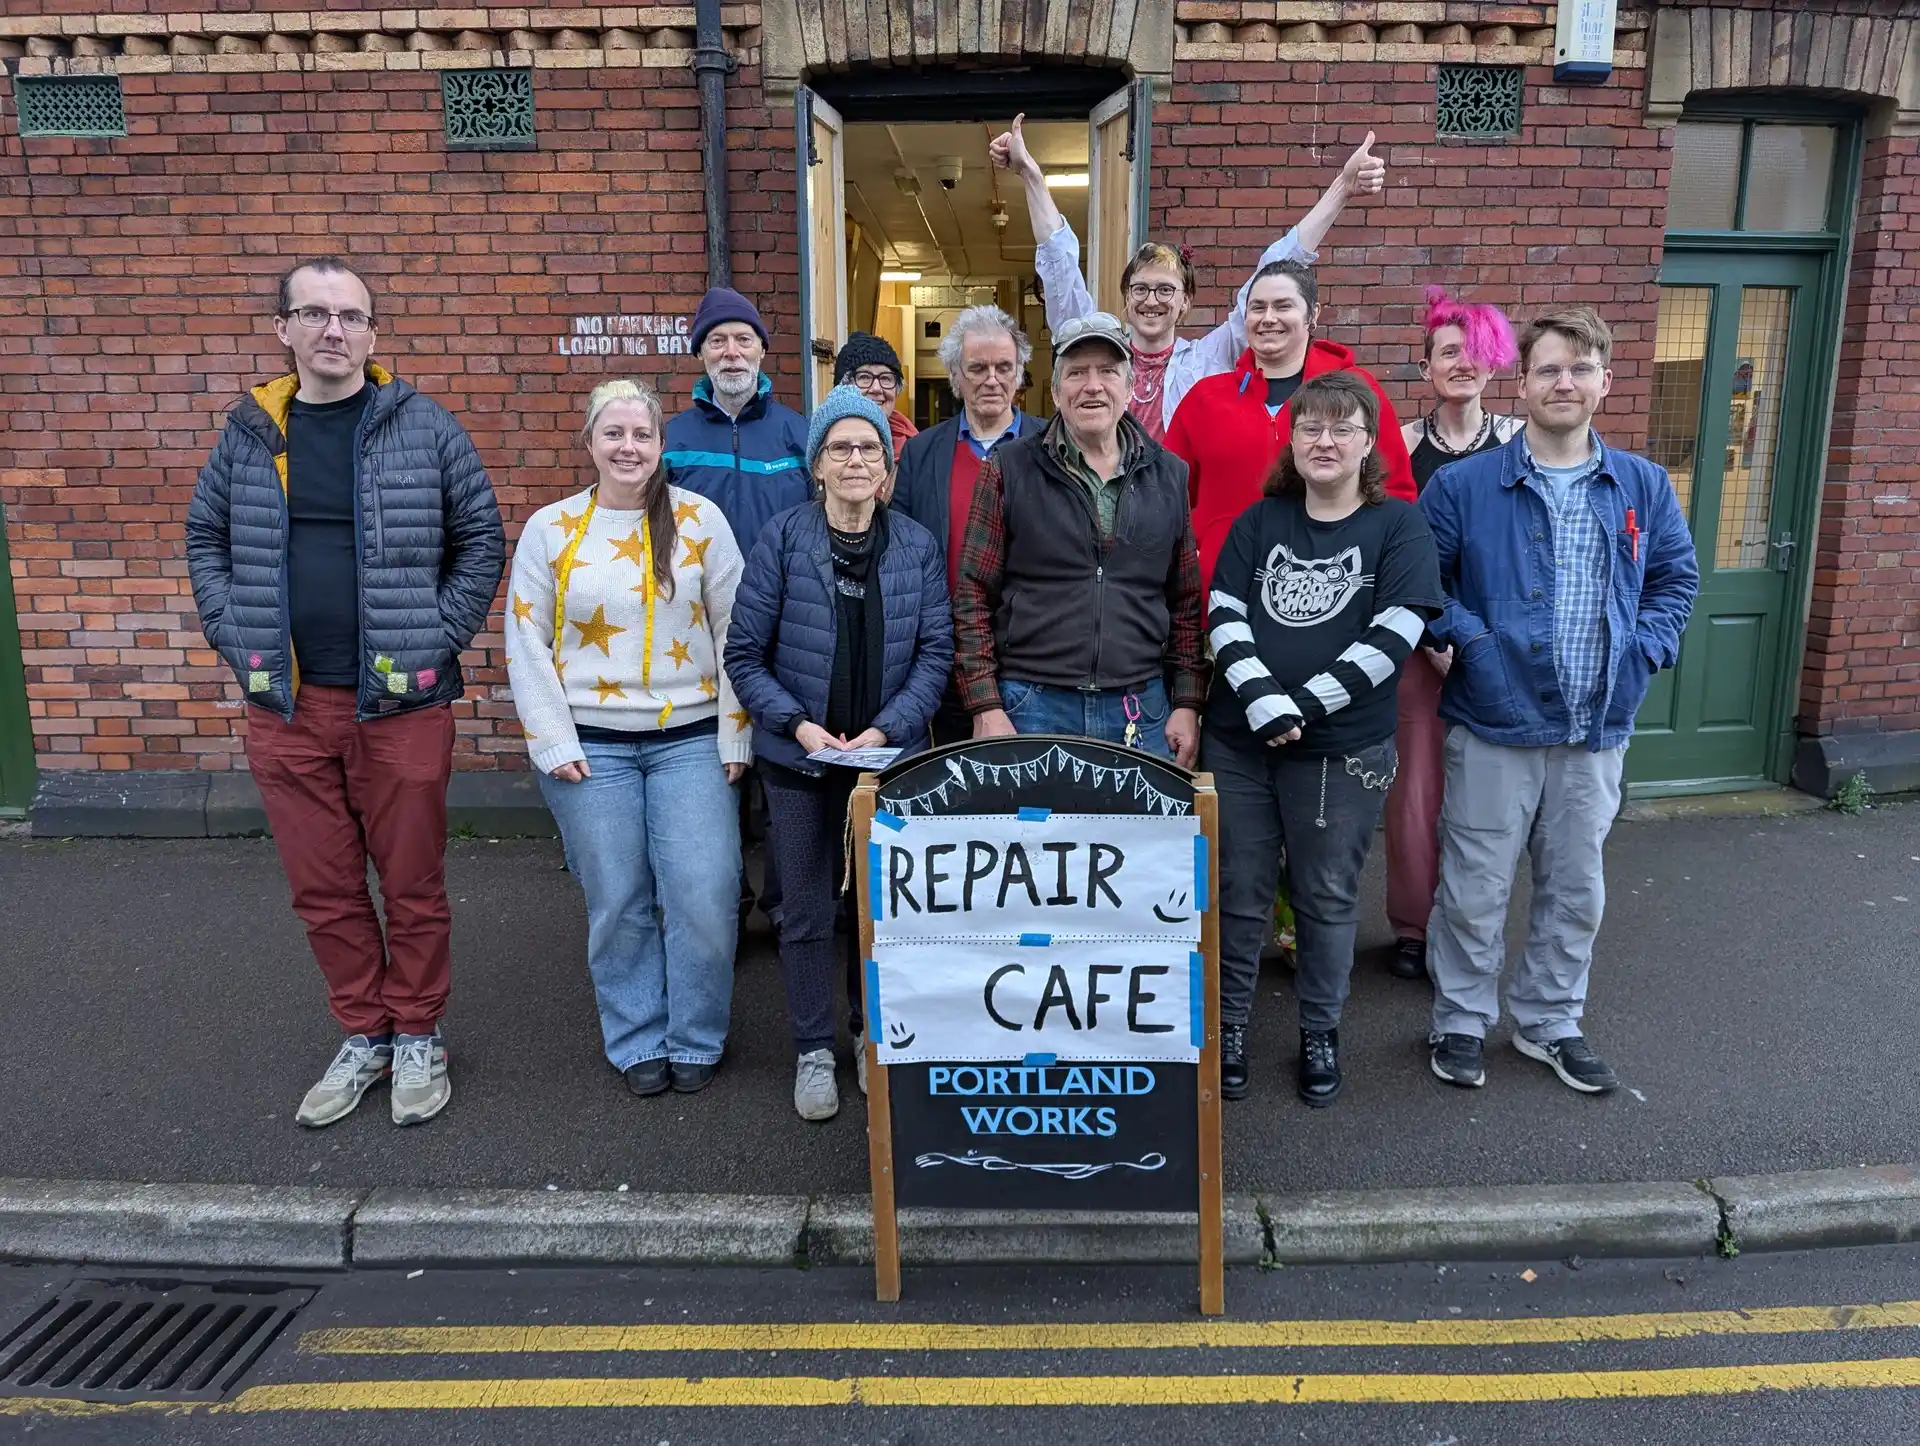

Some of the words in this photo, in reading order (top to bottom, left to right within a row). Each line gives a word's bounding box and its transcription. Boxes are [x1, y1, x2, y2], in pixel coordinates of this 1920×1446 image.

[576, 315, 603, 334] NO
[558, 336, 647, 355] LOADING
[657, 336, 693, 354] BAY
[396, 474, 415, 487] Rab
[1272, 579, 1343, 602] SPOOK
[1278, 592, 1332, 613] SHOW
[889, 840, 1125, 918] REPAIR
[984, 963, 1176, 1033] CAFE
[929, 1066, 1156, 1096] PORTLAND
[960, 1106, 1118, 1136] WORKS
